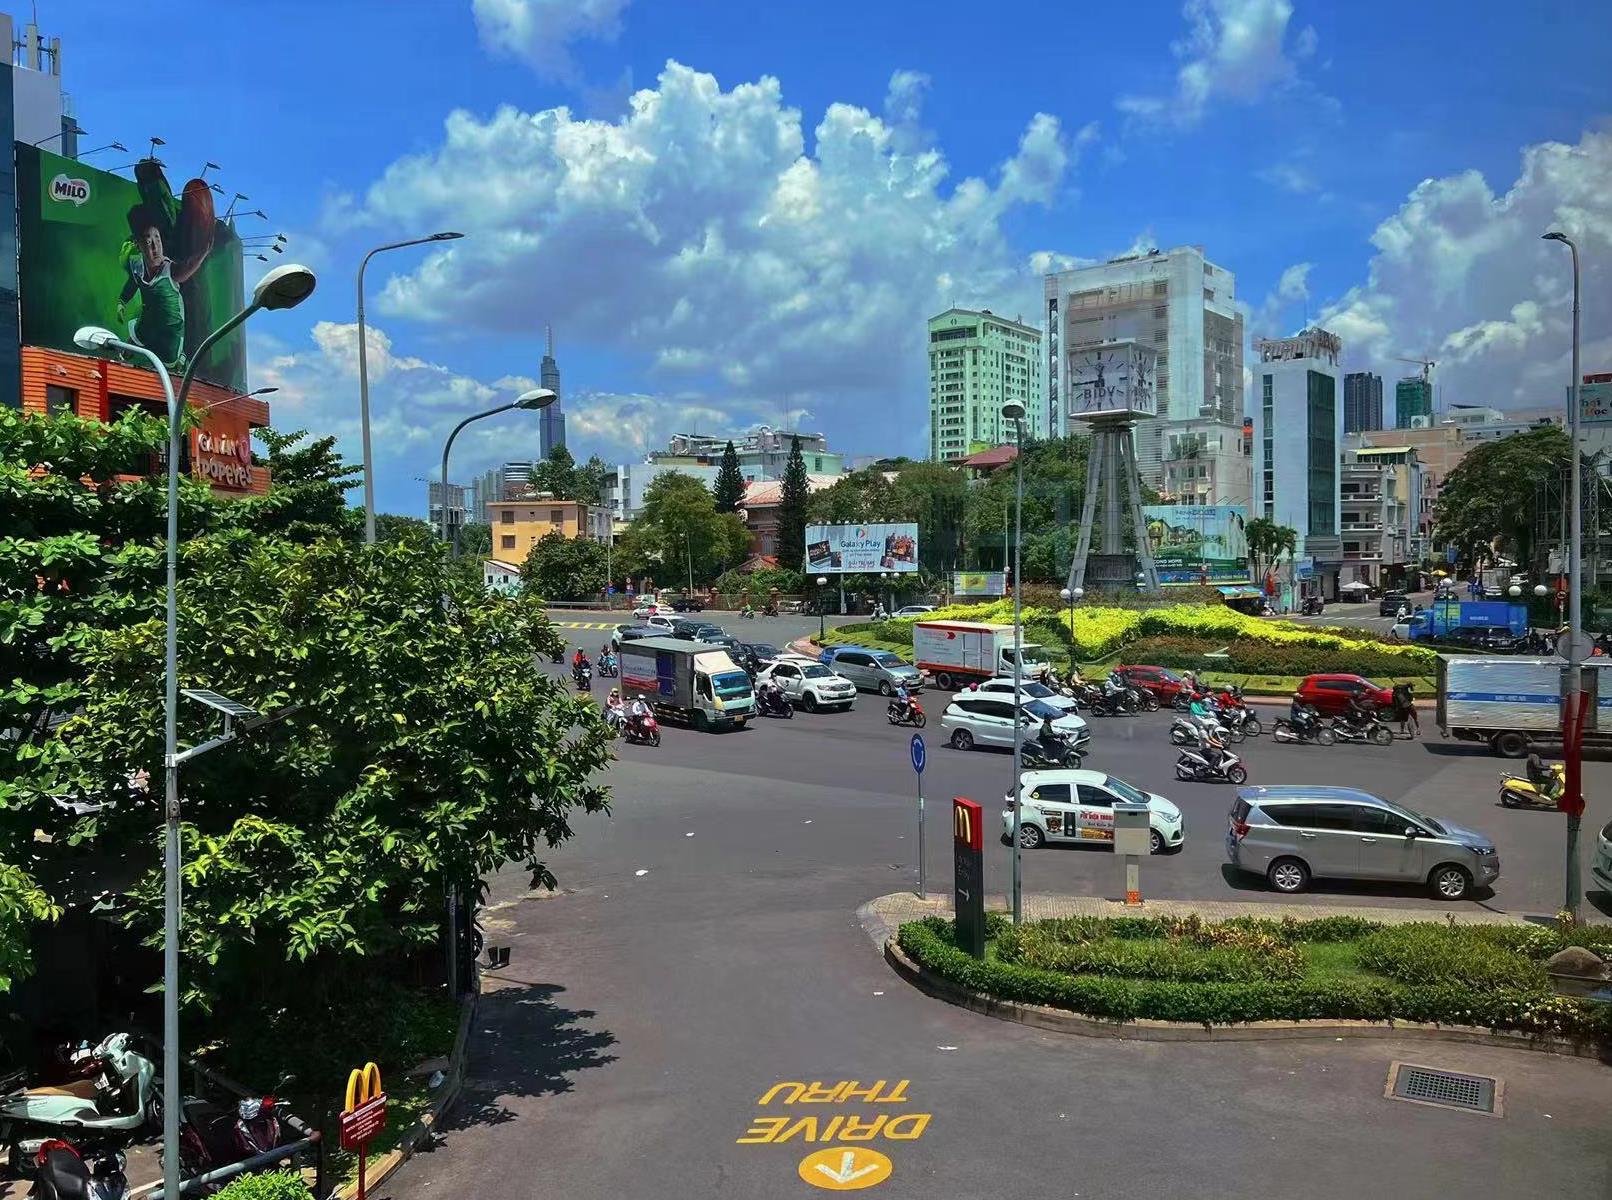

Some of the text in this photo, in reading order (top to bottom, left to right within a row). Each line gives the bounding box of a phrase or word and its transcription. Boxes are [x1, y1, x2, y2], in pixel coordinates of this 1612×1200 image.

[55, 181, 87, 199] MILO
[1083, 386, 1116, 399] BIDV
[840, 540, 881, 548] Galaxy Play
[758, 1079, 911, 1105] THRU
[736, 1114, 932, 1143] DRIVE
